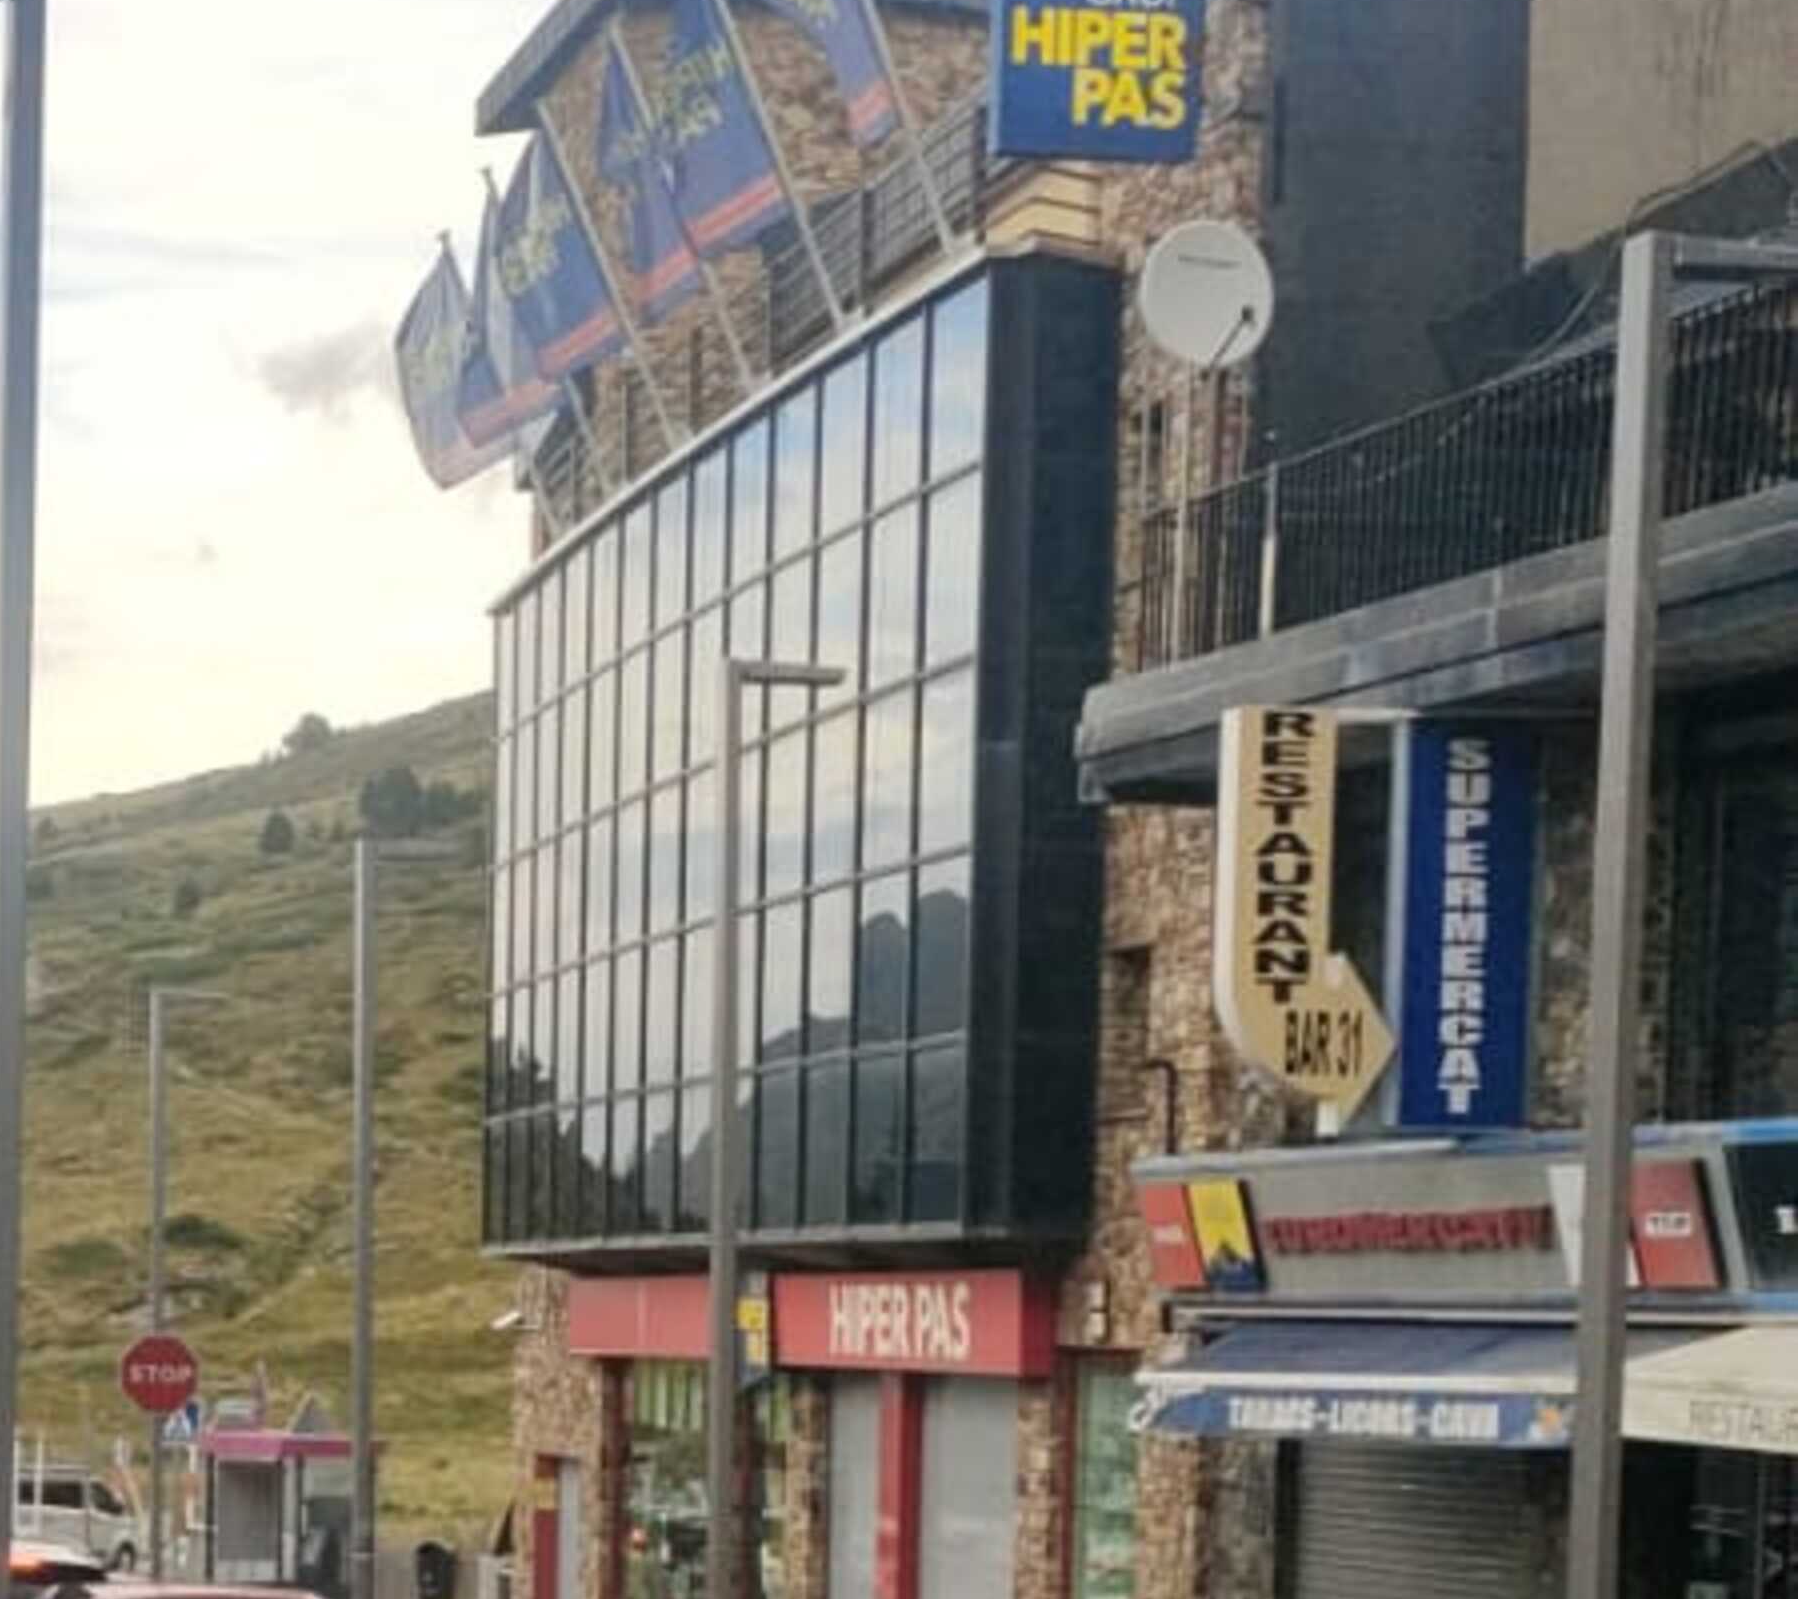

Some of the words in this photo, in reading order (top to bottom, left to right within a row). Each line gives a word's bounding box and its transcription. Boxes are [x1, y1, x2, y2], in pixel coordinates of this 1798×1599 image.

[1010, 3, 1187, 71] HIPER
[1071, 66, 1187, 130] PAS
[1251, 711, 1316, 1005] RESTAURANT
[1437, 737, 1492, 1115] SUPERMERCAT
[1285, 1010, 1333, 1076] BAR
[1336, 1010, 1365, 1079] 31
[828, 1281, 910, 1358] HIPER
[914, 1280, 971, 1361] PAS
[129, 1363, 193, 1384] STOP
